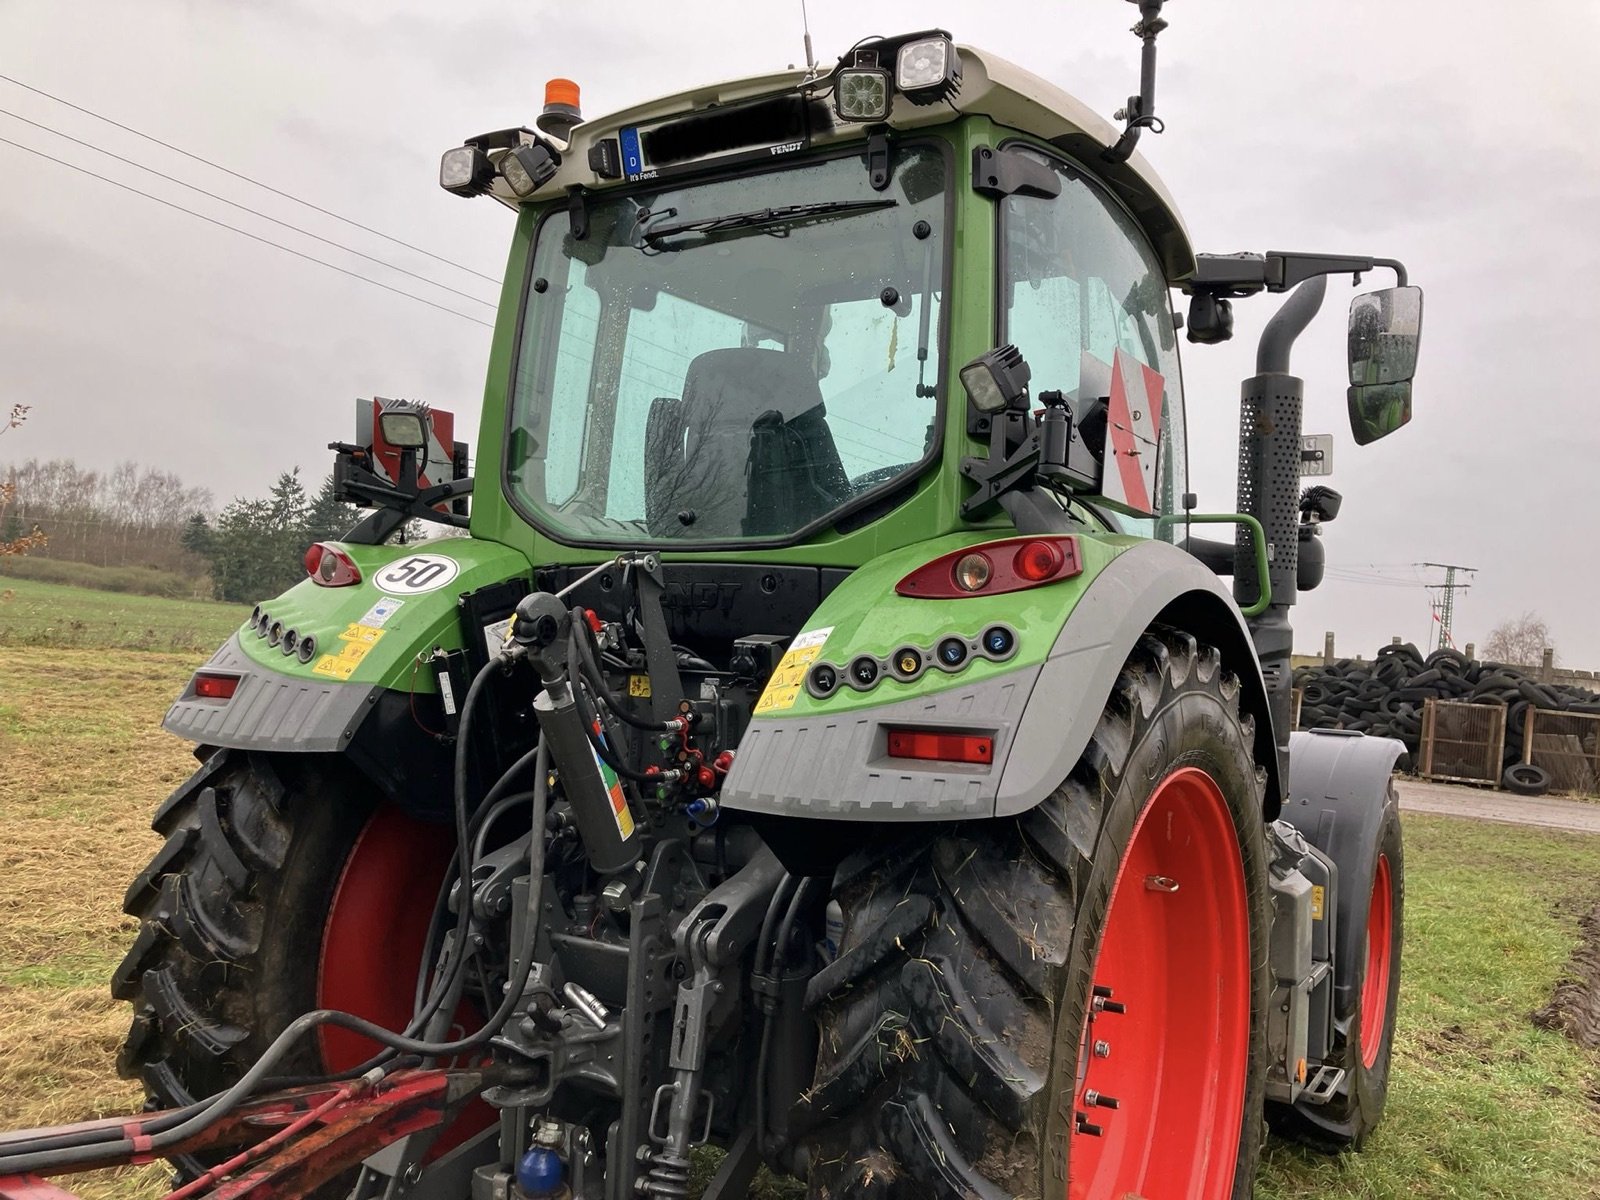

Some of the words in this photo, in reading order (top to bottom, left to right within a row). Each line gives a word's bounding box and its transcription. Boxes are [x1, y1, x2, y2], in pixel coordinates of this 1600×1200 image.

[770, 141, 803, 155] FENDT
[630, 156, 637, 167] D
[630, 173, 640, 182] It's
[385, 557, 448, 588] 50
